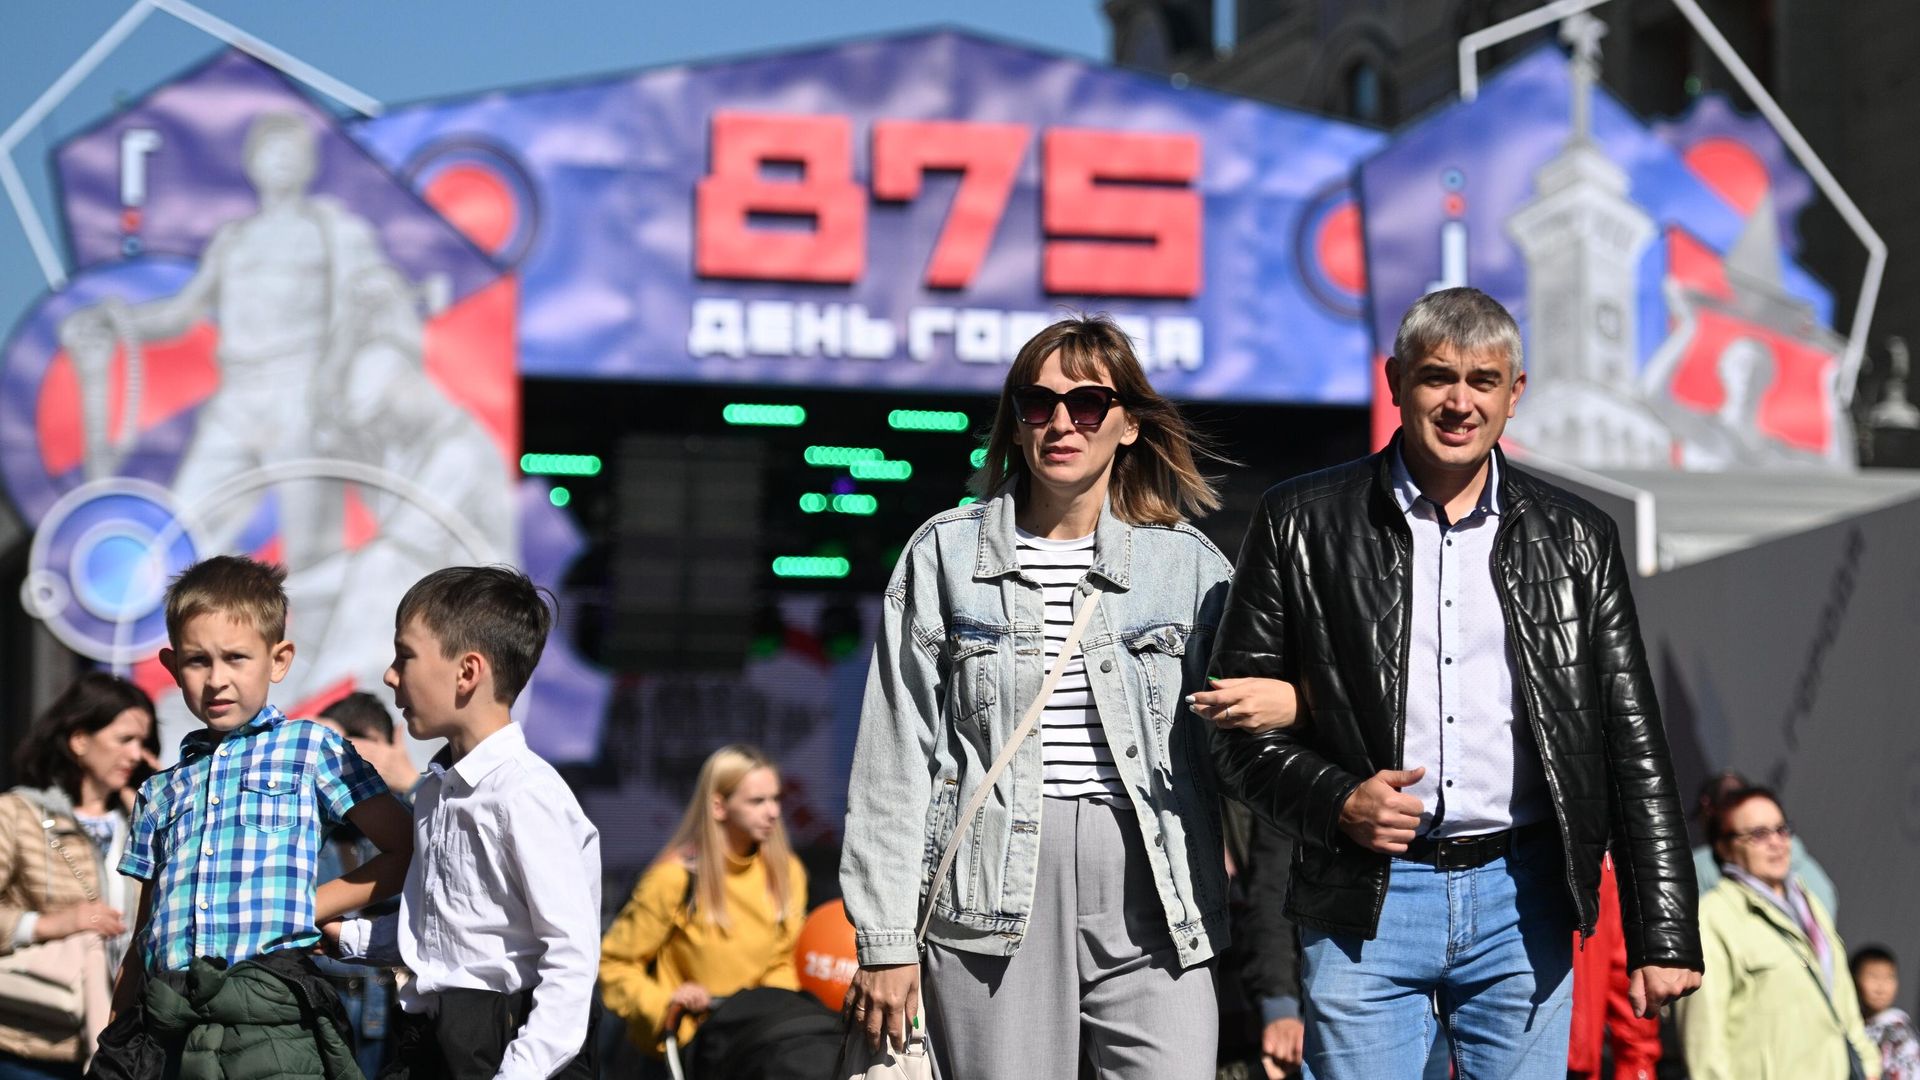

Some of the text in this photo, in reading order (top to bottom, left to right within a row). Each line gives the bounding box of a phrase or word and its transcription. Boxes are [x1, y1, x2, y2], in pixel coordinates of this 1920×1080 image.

[695, 111, 1202, 297] 875
[688, 299, 1203, 371] ДЕНЬ ГОРА
